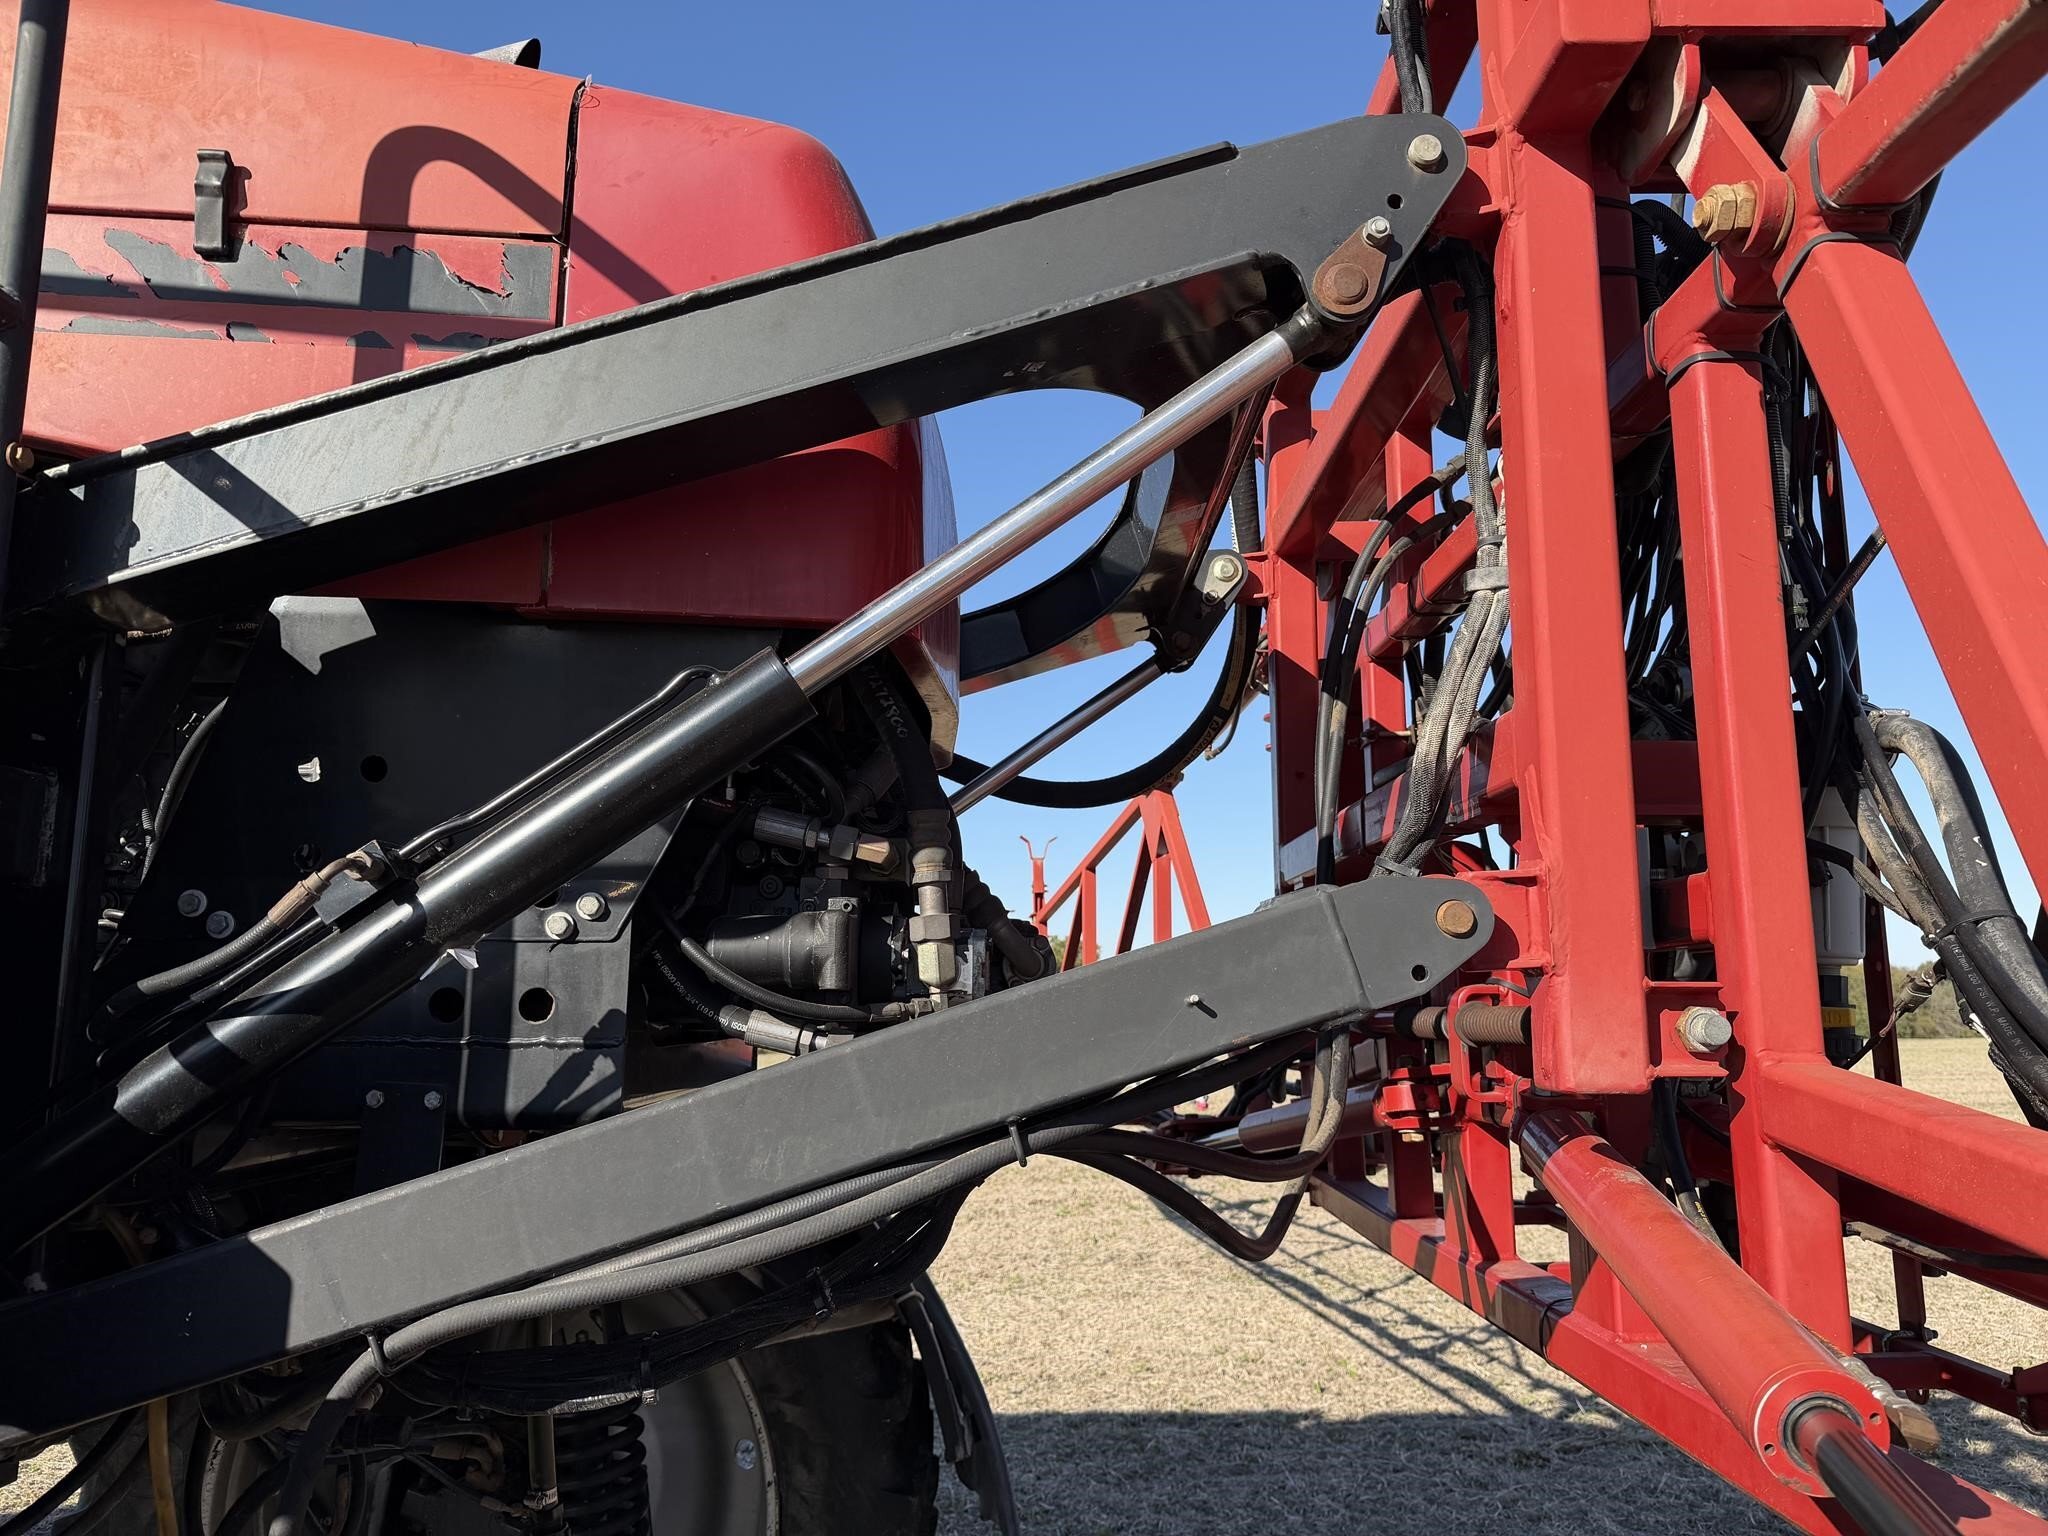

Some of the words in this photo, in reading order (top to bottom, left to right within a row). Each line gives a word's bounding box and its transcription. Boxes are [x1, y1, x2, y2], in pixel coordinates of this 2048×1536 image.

[1998, 1018, 2015, 1037] MADE
[2012, 1038, 2022, 1047] IN
[2019, 1047, 2033, 1060] USA
